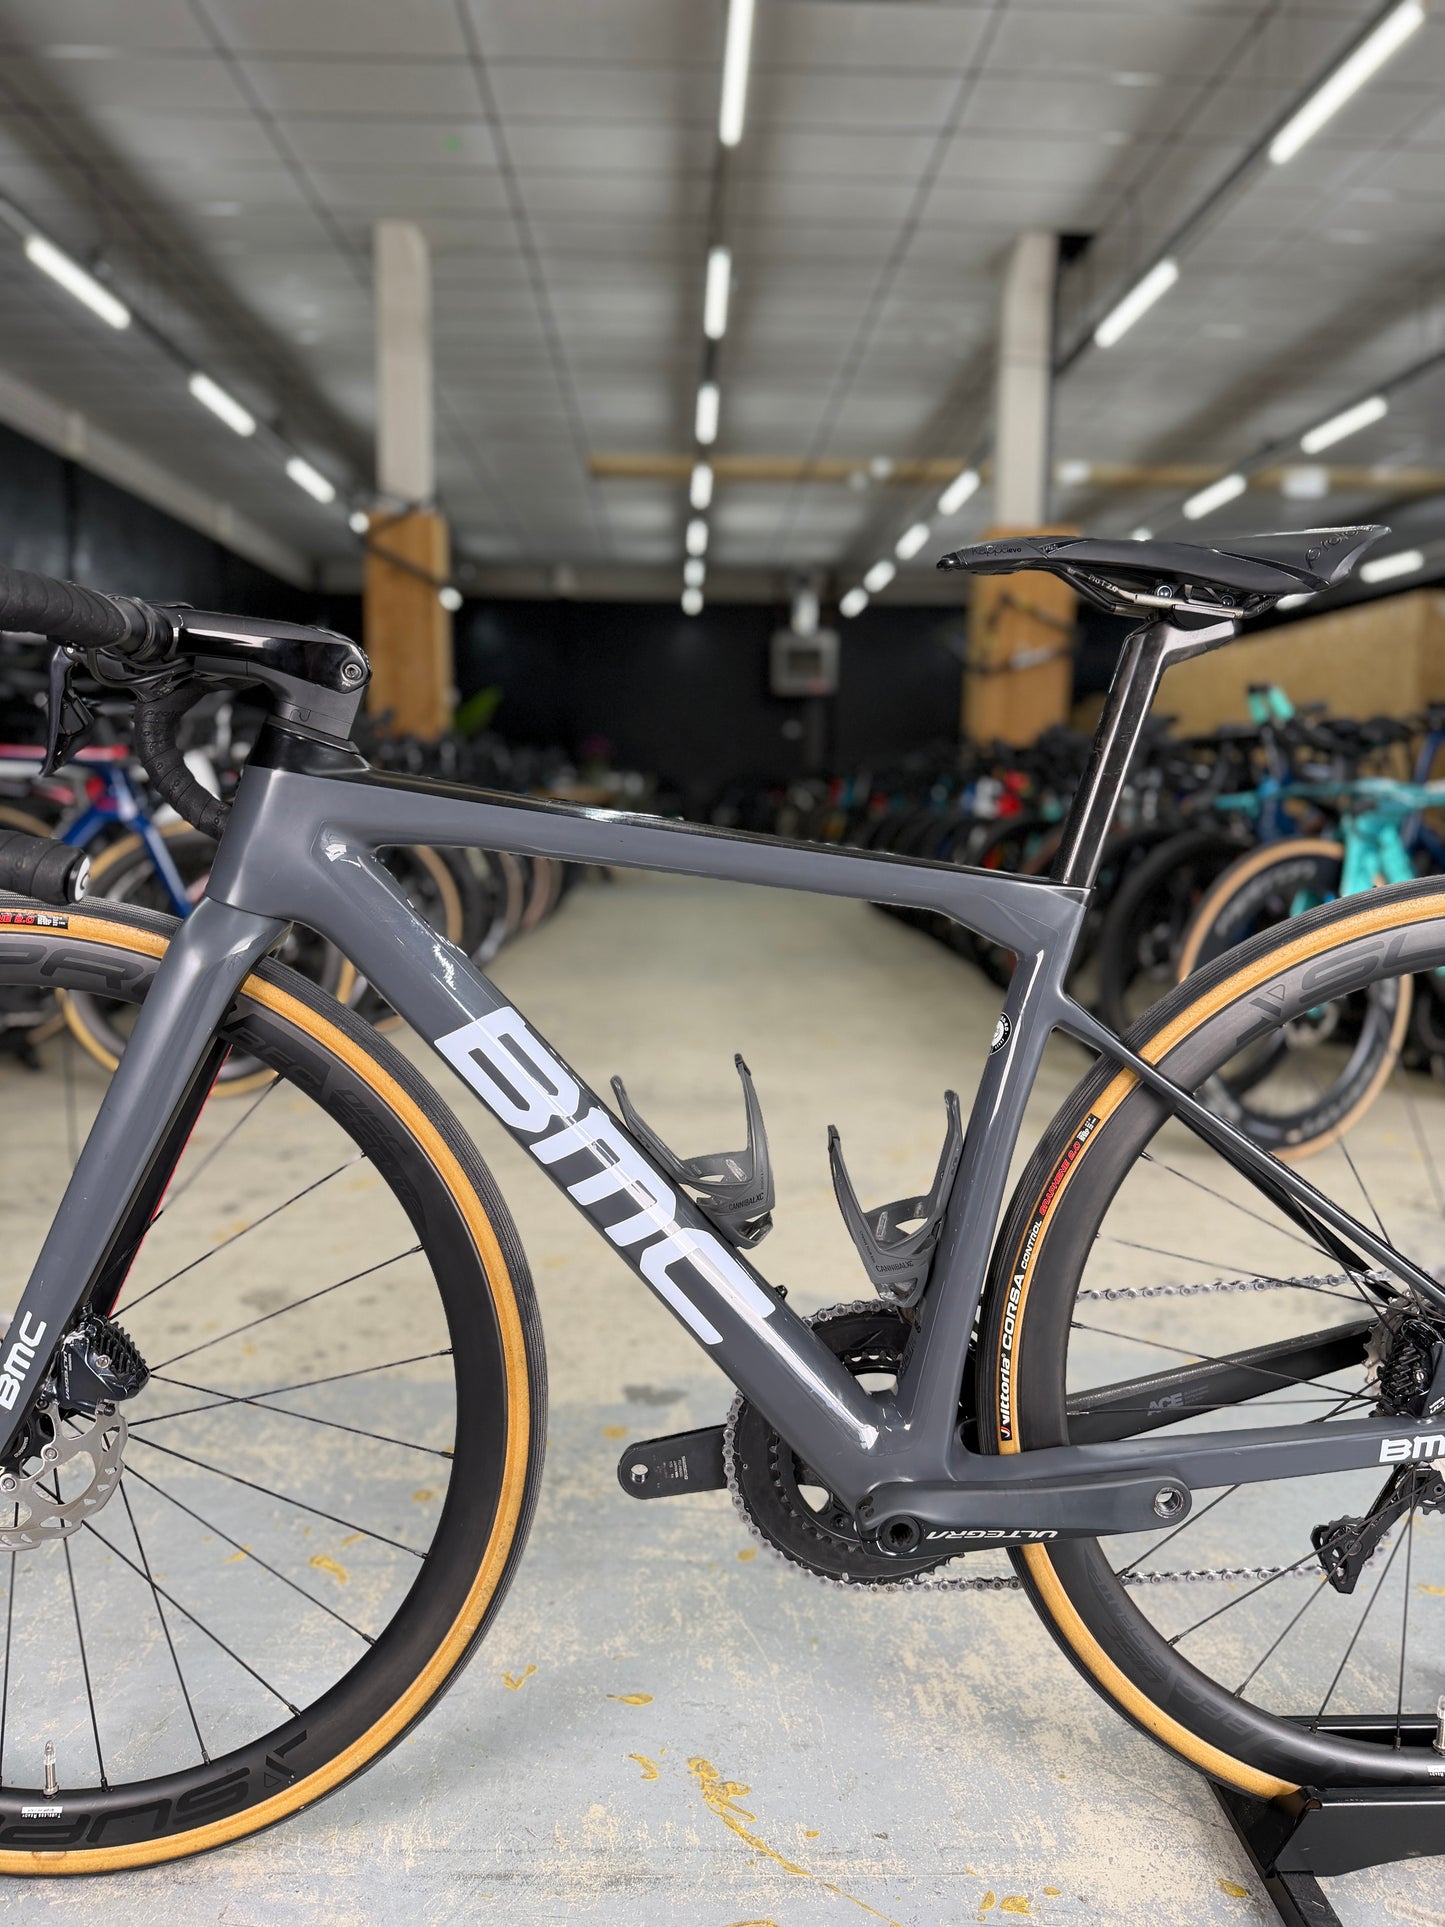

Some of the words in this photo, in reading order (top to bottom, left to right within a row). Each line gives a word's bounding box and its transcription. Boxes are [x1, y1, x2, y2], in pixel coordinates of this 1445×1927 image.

[433, 1005, 776, 1345] BMC
[1002, 1274, 1025, 1351] CORSA
[1020, 1220, 1043, 1270] CONTROL
[1067, 1141, 1081, 1161] 2.0
[0, 1310, 48, 1411] BMC
[925, 1530, 1059, 1540] ULTEGRA
